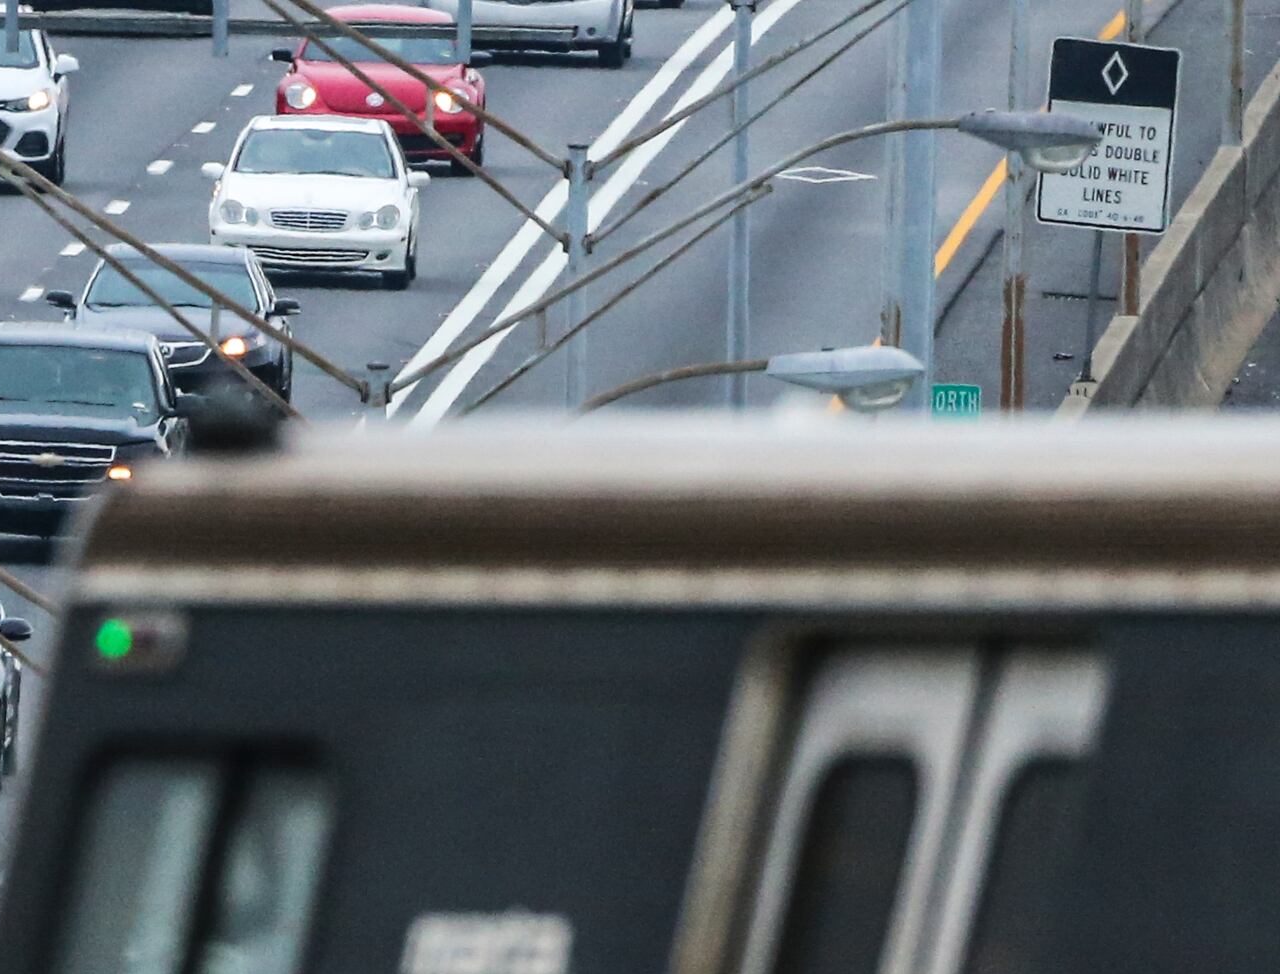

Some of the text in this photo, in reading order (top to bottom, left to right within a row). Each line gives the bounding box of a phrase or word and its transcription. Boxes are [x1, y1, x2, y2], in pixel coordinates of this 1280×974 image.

[1140, 126, 1157, 140] TO
[1105, 145, 1160, 163] DOUBLE
[1108, 167, 1149, 185] WHITE
[1083, 187, 1122, 203] LINES
[936, 391, 977, 412] ORTH
